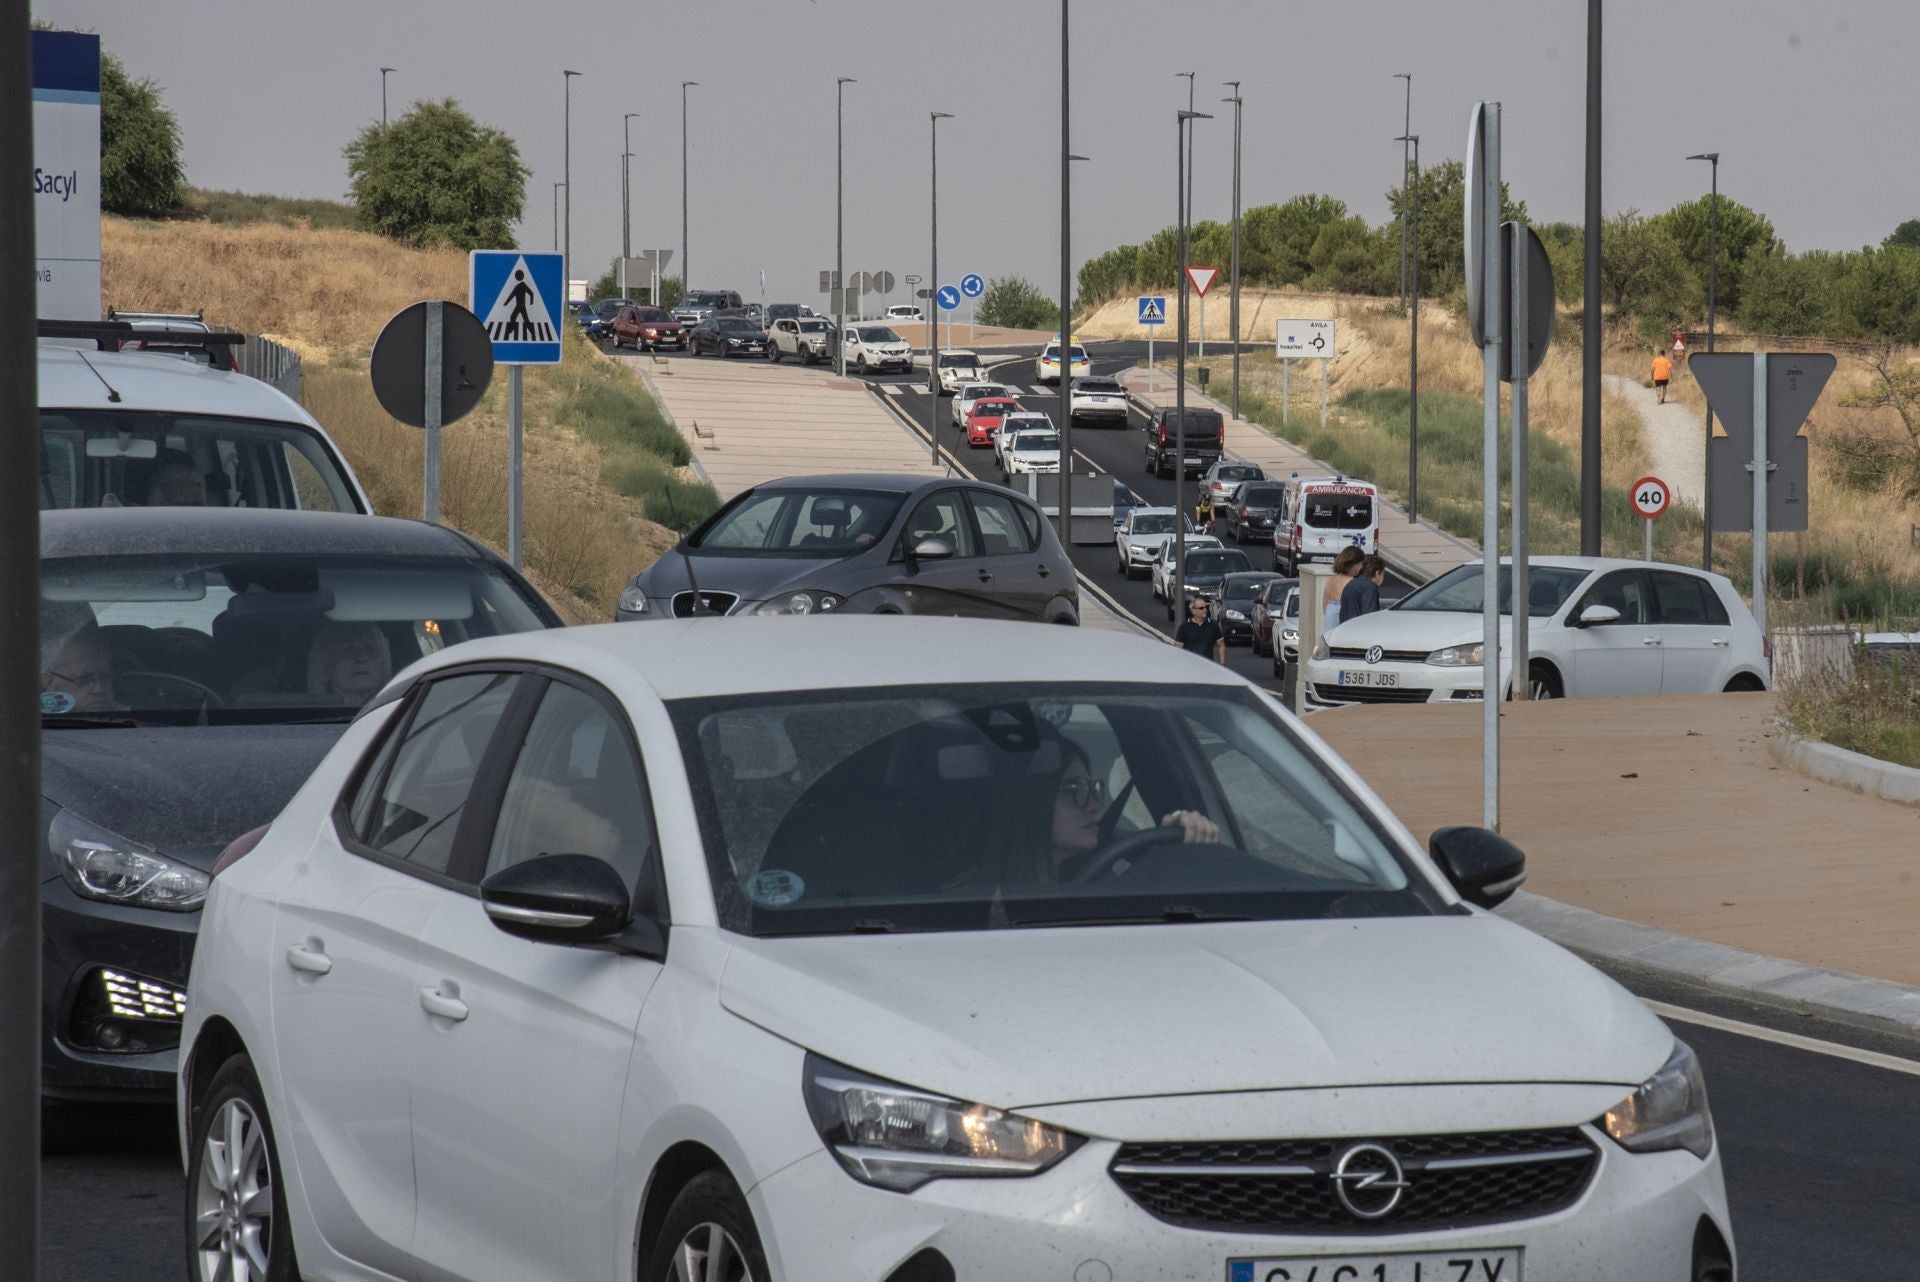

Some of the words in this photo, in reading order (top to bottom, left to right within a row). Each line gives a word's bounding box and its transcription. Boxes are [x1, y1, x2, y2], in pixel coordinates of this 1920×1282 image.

[35, 168, 77, 201] Sacyl
[1311, 485, 1368, 495] AMBULANCIA
[1638, 491, 1662, 504] 40
[1345, 672, 1370, 685] 5361
[1375, 674, 1396, 686] JDS
